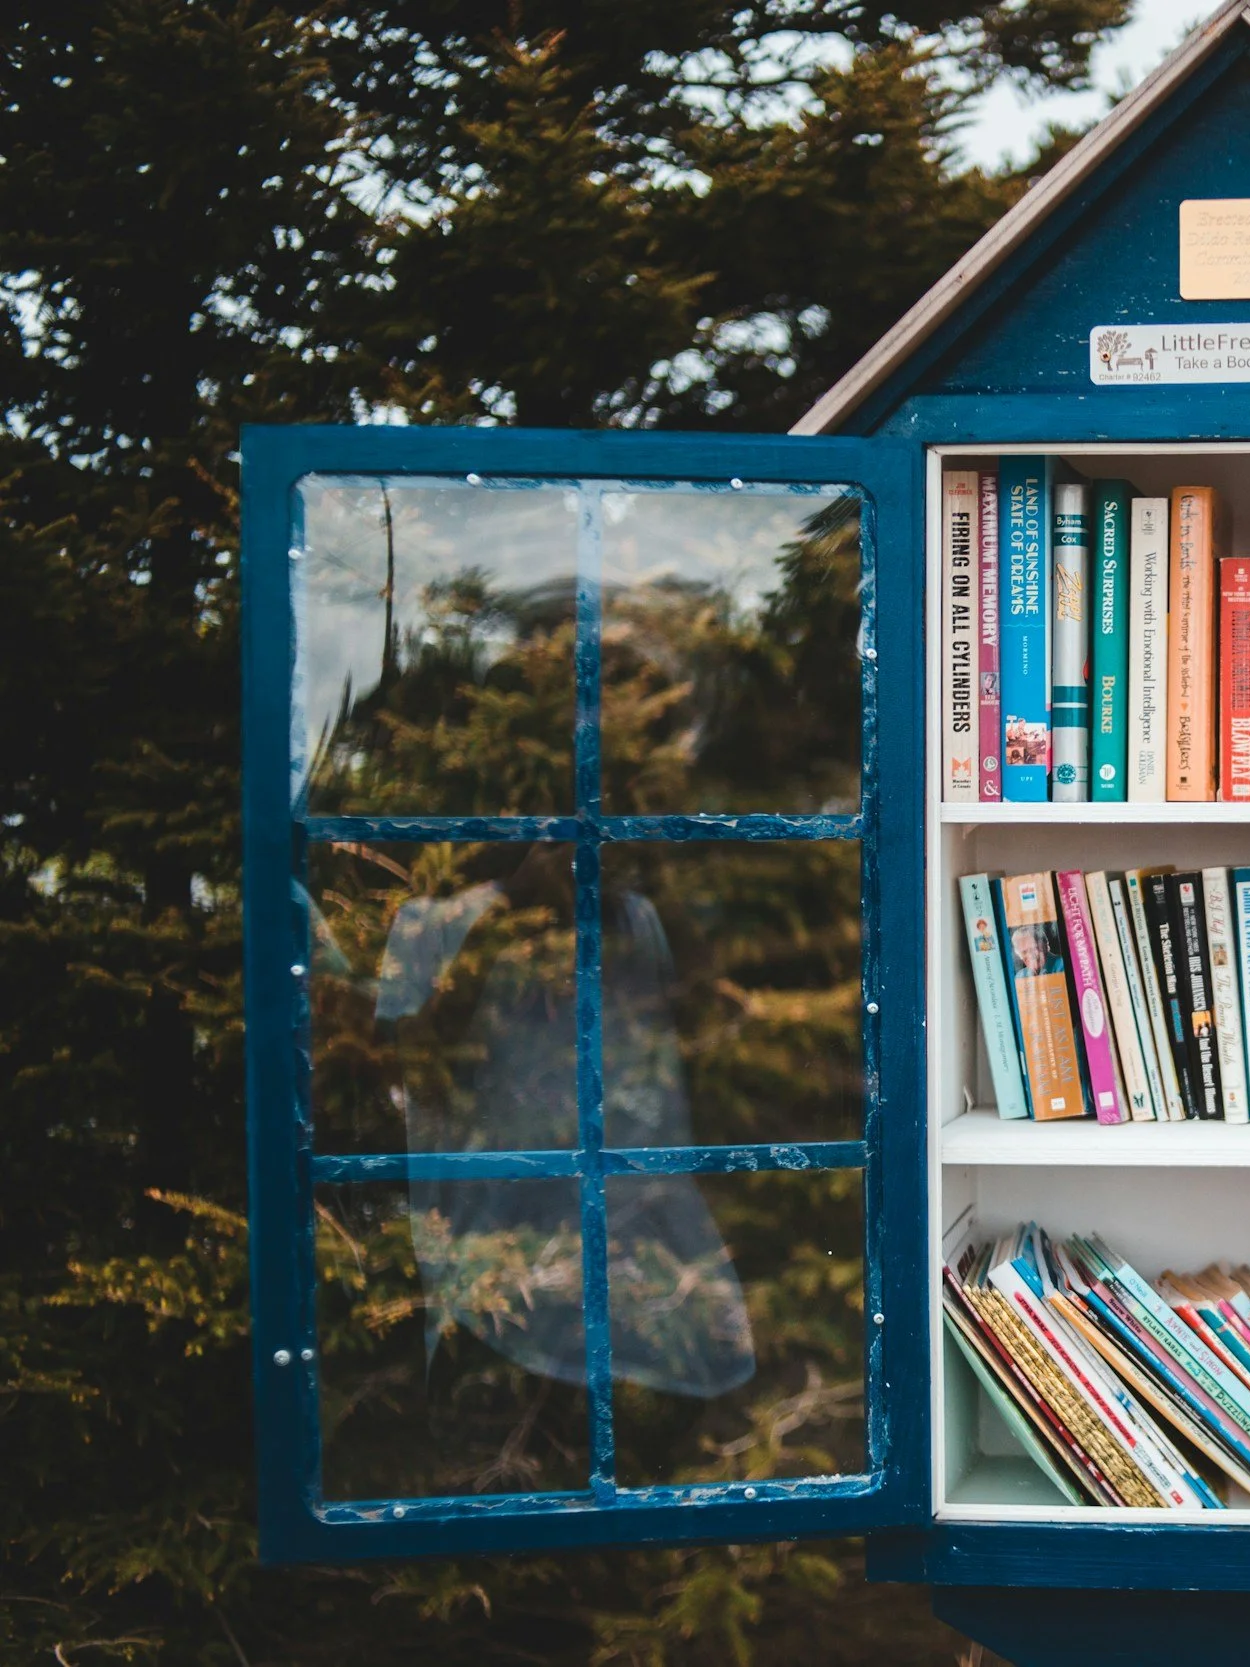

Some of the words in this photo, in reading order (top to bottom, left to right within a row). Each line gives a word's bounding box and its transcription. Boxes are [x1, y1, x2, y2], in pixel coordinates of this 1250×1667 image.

[1133, 372, 1161, 382] 92462
[1175, 357, 1210, 370] Take
[1213, 360, 1221, 368] a
[1010, 485, 1023, 528] STATE
[1024, 478, 1038, 516] LAND
[1180, 495, 1198, 520] Girls
[982, 476, 998, 566] MAXIMUM
[1024, 519, 1038, 539] OF
[1057, 516, 1082, 528] Byham
[1103, 501, 1117, 556] SACRED
[1180, 525, 1190, 537] in
[952, 512, 969, 566] FIRING
[1010, 530, 1023, 551] OF
[1061, 535, 1077, 544] Cox
[1180, 542, 1197, 569] Pants
[952, 575, 969, 597] ON
[1010, 554, 1023, 614] DREAMS
[1024, 544, 1038, 616] SUNSHINE,
[1139, 552, 1156, 596] Working
[982, 569, 998, 646] MEMORY
[1102, 559, 1116, 633] SURPRISES
[952, 604, 969, 632] ALL
[1143, 600, 1156, 624] with
[1143, 629, 1156, 681] Emotional
[952, 641, 969, 732] CYLINDERS
[1101, 675, 1115, 733] BOURKE
[1138, 686, 1156, 743] Intelligence
[1146, 750, 1154, 775] DANIEL
[1067, 886, 1081, 917] LIGHT
[1072, 918, 1085, 939] FOR
[1159, 922, 1170, 938] The
[1075, 938, 1088, 958] MY
[1160, 938, 1175, 974] Skeleton
[1078, 957, 1093, 987] PATH
[1188, 955, 1201, 972] IRIS
[1146, 975, 1155, 995] Secret
[1166, 975, 1177, 993] Man
[1190, 973, 1205, 1011] JOHANSEN
[1215, 971, 1230, 992] The
[1150, 997, 1158, 1016] Seven
[1215, 995, 1233, 1027] Penny
[1199, 1037, 1210, 1050] And
[1200, 1051, 1211, 1063] the
[1220, 1031, 1237, 1065] Whistle
[1201, 1063, 1213, 1086] Desert
[1204, 1087, 1216, 1113] Blooms
[1107, 1298, 1125, 1316] Snow
[1123, 1314, 1143, 1333] White
[1164, 1316, 1190, 1343] ANNIE
[1188, 1340, 1201, 1352] and
[1197, 1351, 1224, 1377] SIMON
[1129, 1366, 1149, 1385] FRUIT
[1166, 1402, 1191, 1426] FRENZY
[1188, 1424, 1211, 1446] FORCE
